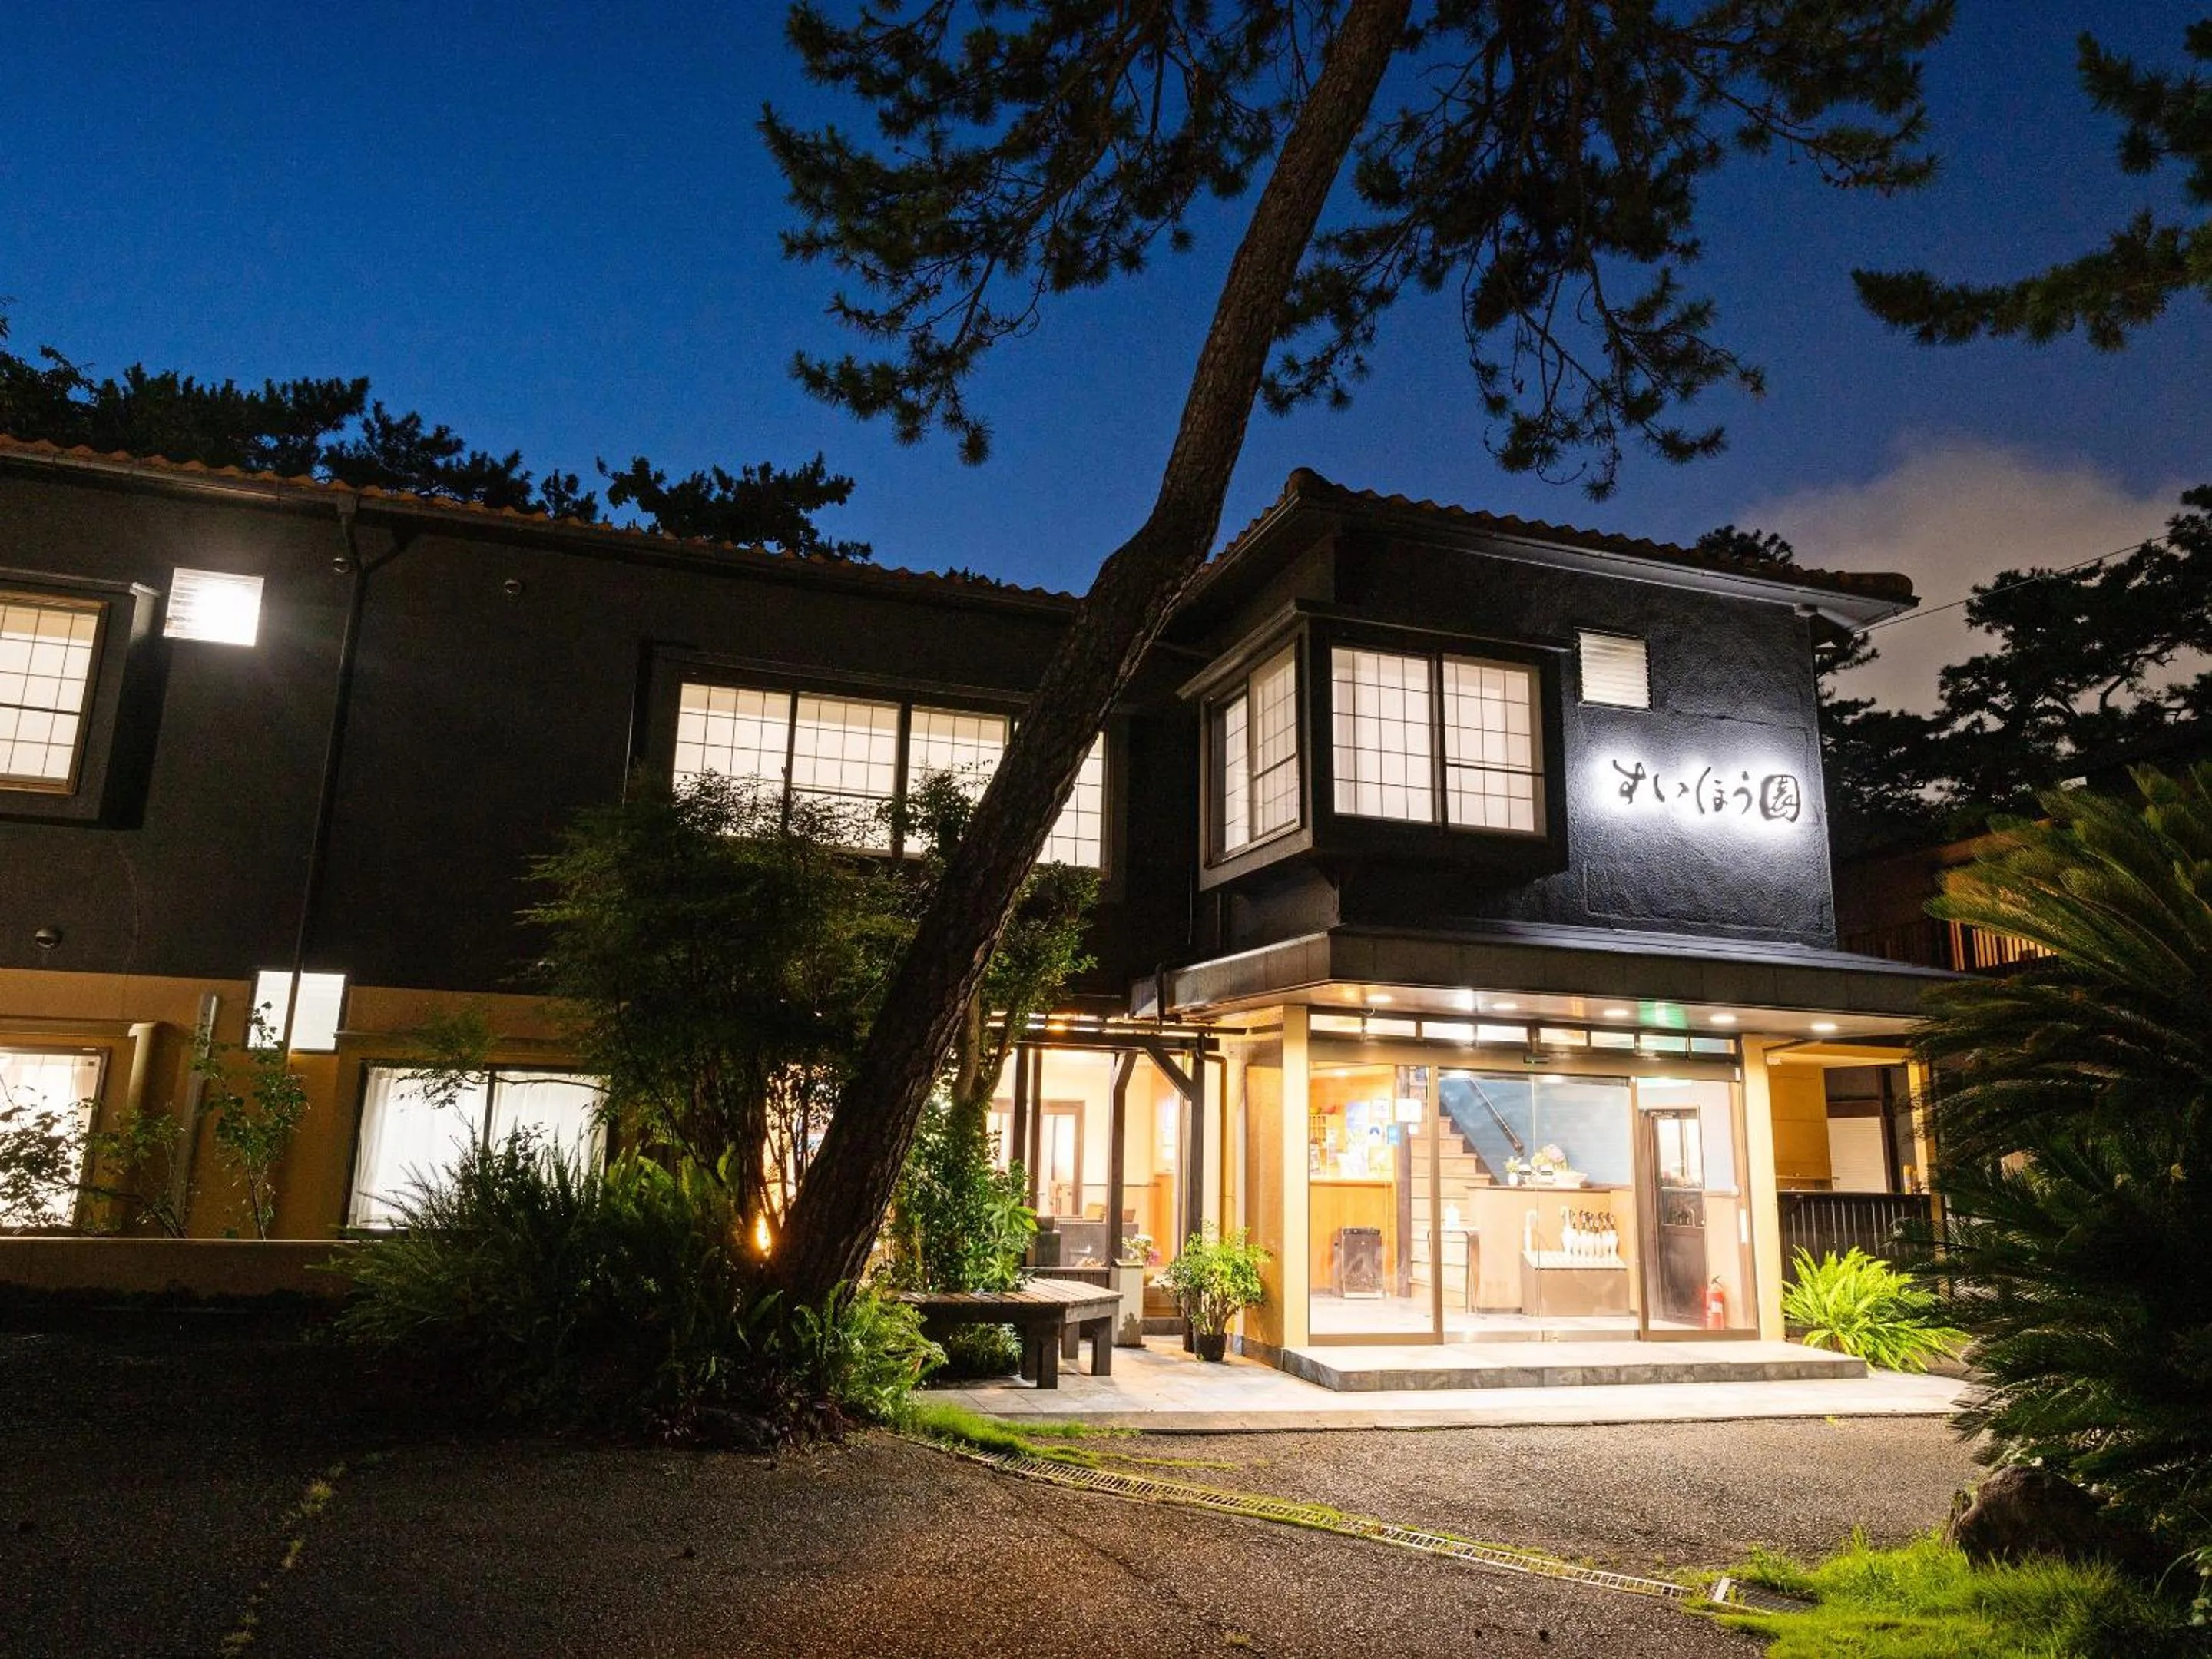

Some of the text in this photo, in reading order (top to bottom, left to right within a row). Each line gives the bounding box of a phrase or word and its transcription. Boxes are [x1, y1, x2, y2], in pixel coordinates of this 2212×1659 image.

[1612, 759, 1801, 823] すいほう園
